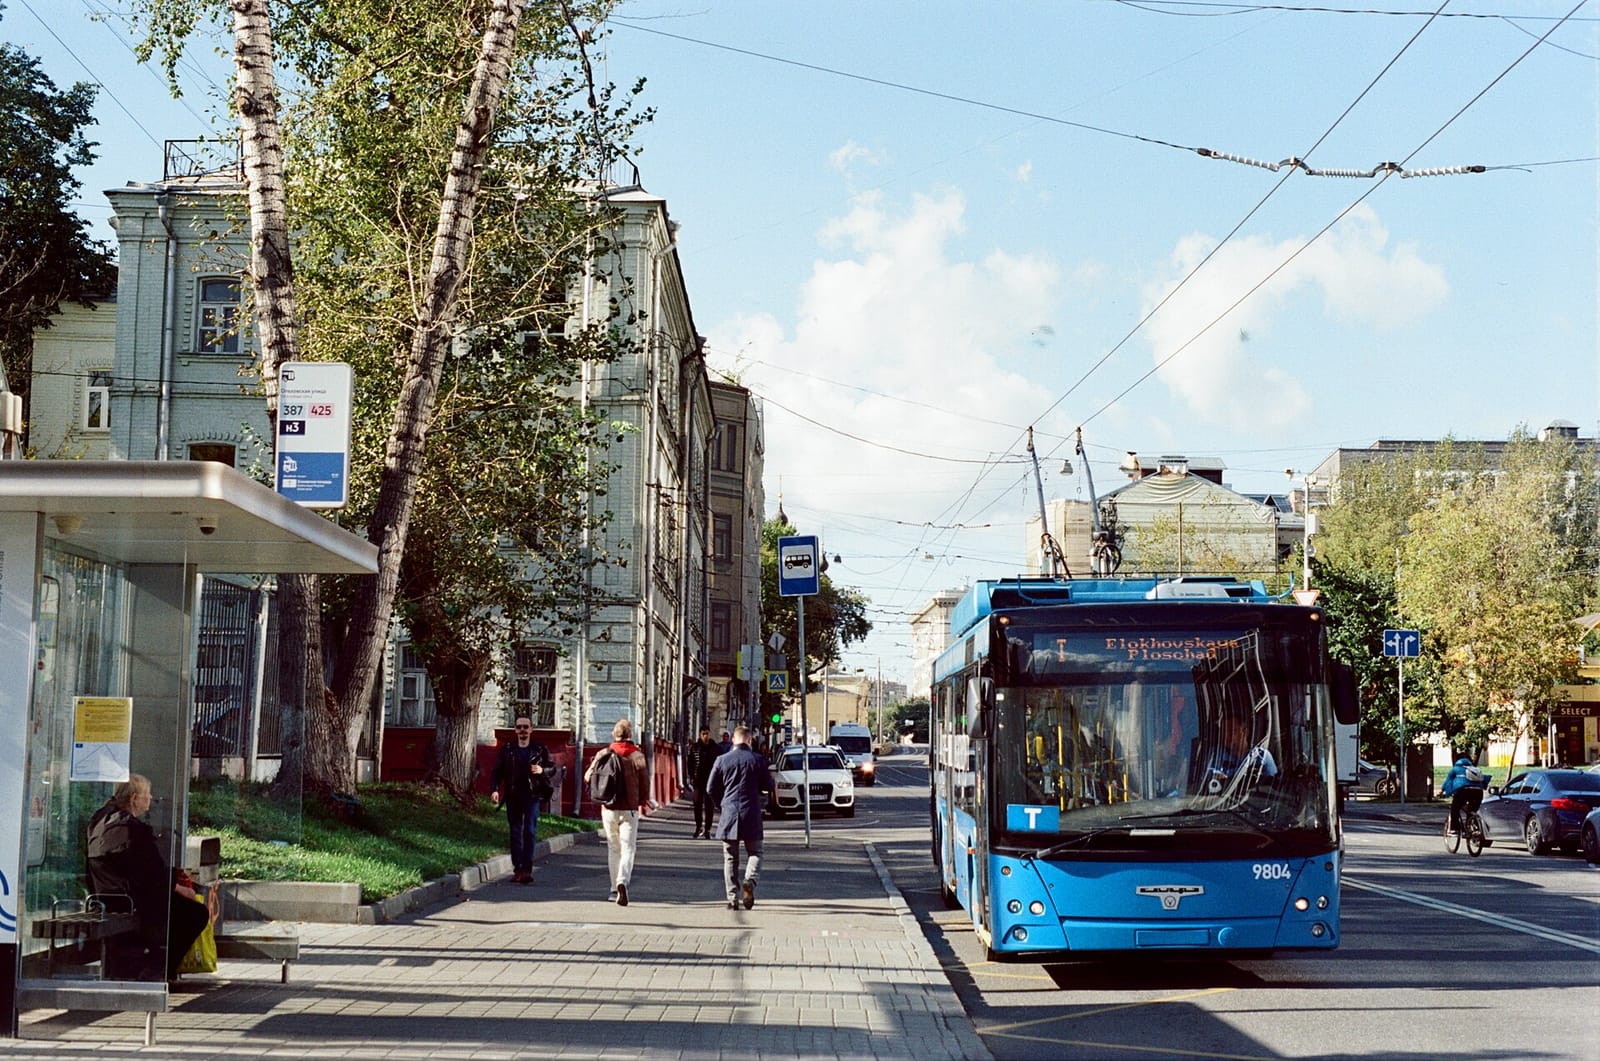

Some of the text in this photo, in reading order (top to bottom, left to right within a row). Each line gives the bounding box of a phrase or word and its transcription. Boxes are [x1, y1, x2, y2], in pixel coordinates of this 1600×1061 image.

[283, 405, 332, 416] 387 425
[1127, 648, 1216, 660] Ploschad
[1560, 707, 1591, 716] SELECT
[1024, 808, 1042, 829] T
[1252, 863, 1291, 880] 9804
